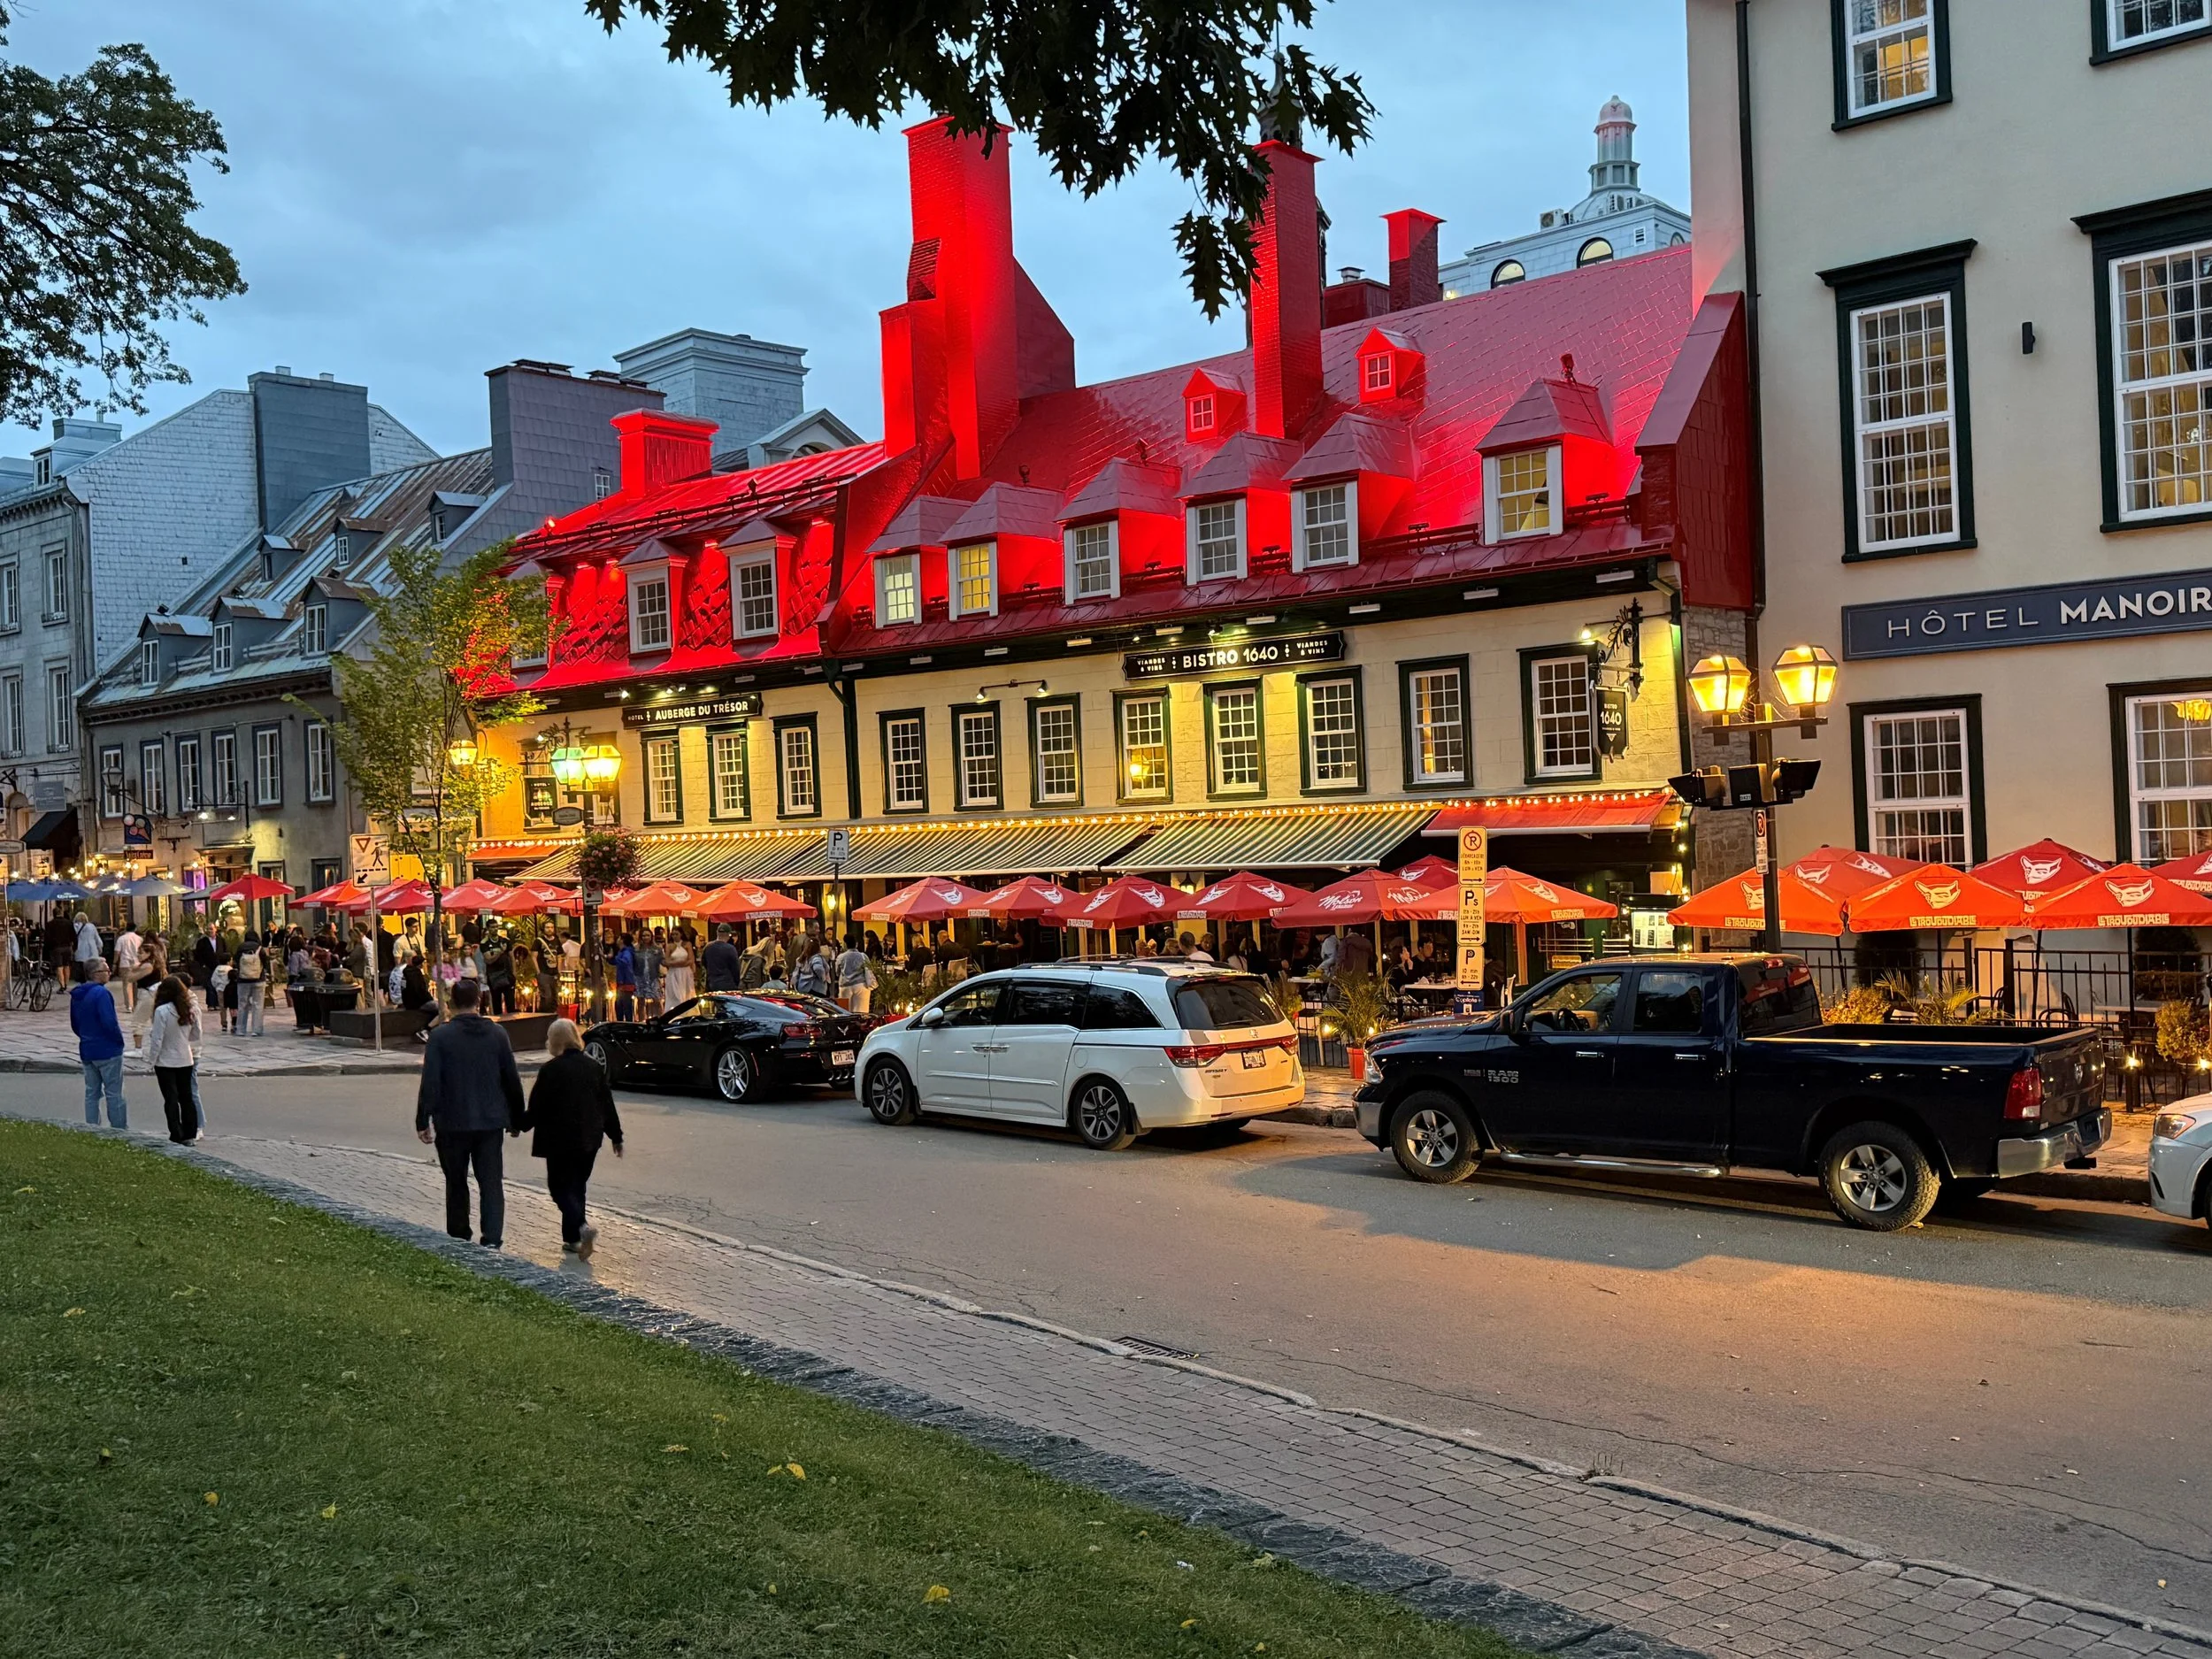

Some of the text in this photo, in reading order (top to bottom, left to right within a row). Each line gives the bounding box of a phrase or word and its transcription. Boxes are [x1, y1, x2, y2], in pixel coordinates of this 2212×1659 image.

[1887, 587, 2212, 639] HÔTEL MANOIR
[1183, 646, 1279, 668] BISTRO 1640
[655, 707, 696, 721] AUBERGE
[698, 705, 710, 716] DU
[713, 701, 749, 714] TRÉSOR
[1601, 710, 1622, 726] 1640
[833, 833, 843, 847] P
[1466, 949, 1475, 964] P
